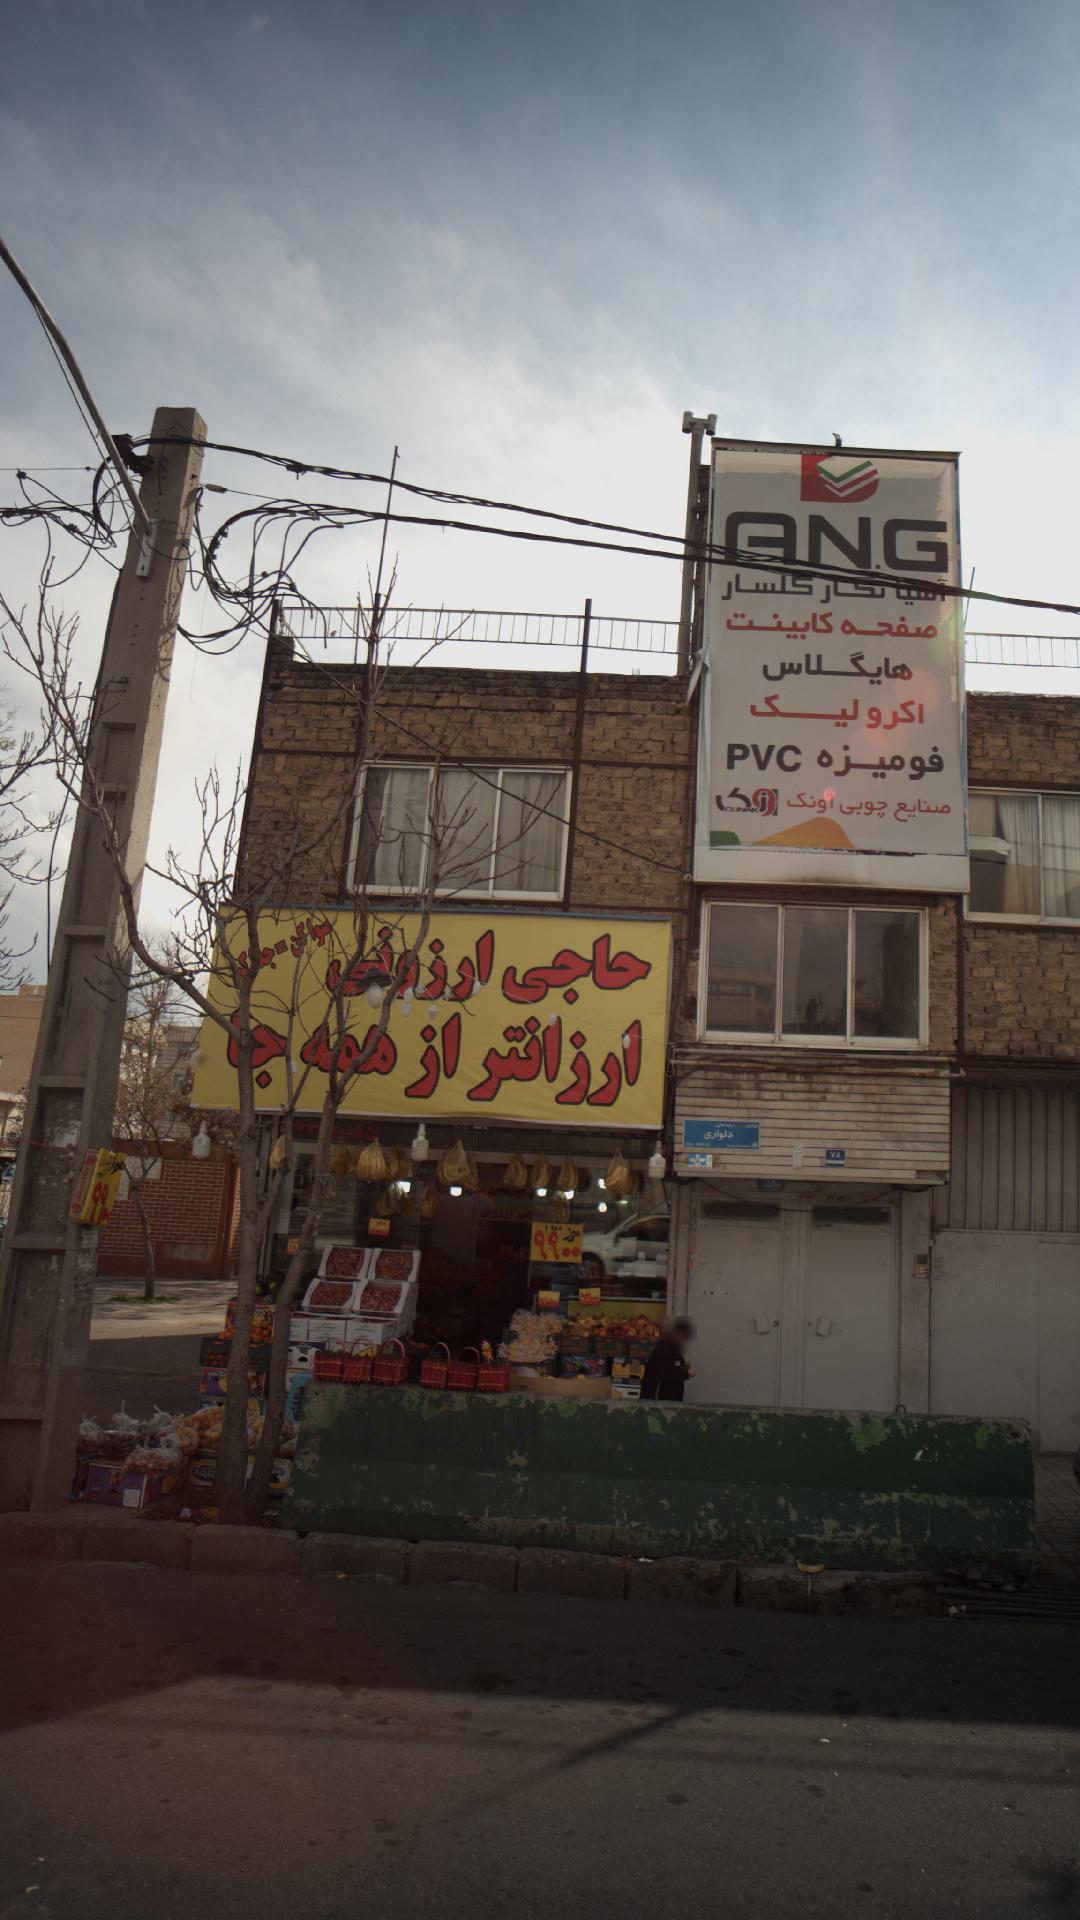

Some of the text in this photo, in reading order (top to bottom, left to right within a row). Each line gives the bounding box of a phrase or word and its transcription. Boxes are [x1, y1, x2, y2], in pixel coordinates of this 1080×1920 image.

[726, 611, 938, 640] صفحه کابینت
[762, 651, 913, 686] هایگلاس
[750, 694, 924, 730] اکرولیک
[726, 743, 802, 773] PVC
[816, 744, 945, 781] فومیزه
[839, 799, 889, 818] چوبی
[893, 798, 951, 822] صنایع
[502, 932, 652, 1005] حاجی
[227, 1008, 643, 1106] ارزانتر از همه جا
[703, 1129, 734, 1141] دلواری
